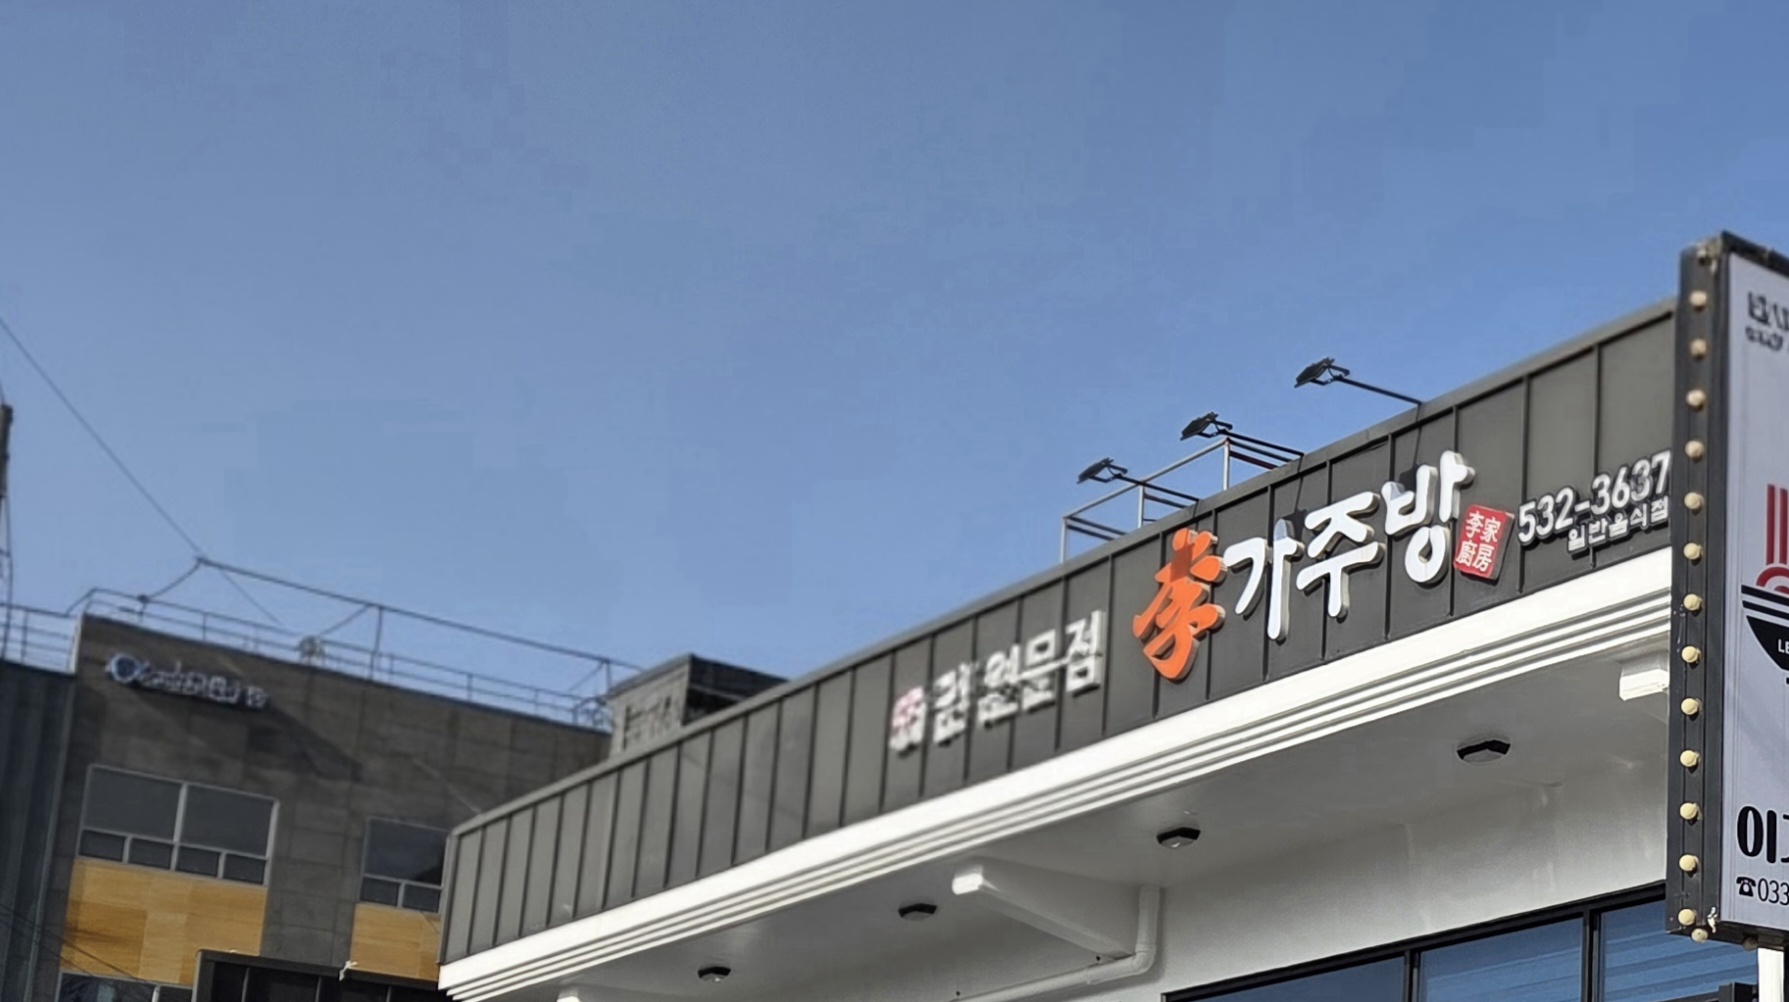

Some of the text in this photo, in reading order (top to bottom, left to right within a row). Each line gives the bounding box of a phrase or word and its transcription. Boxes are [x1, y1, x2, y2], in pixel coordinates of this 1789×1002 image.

[1518, 451, 1671, 544] 532-3637
[1568, 496, 1668, 551] 일반음식점
[1464, 510, 1502, 543] 李家
